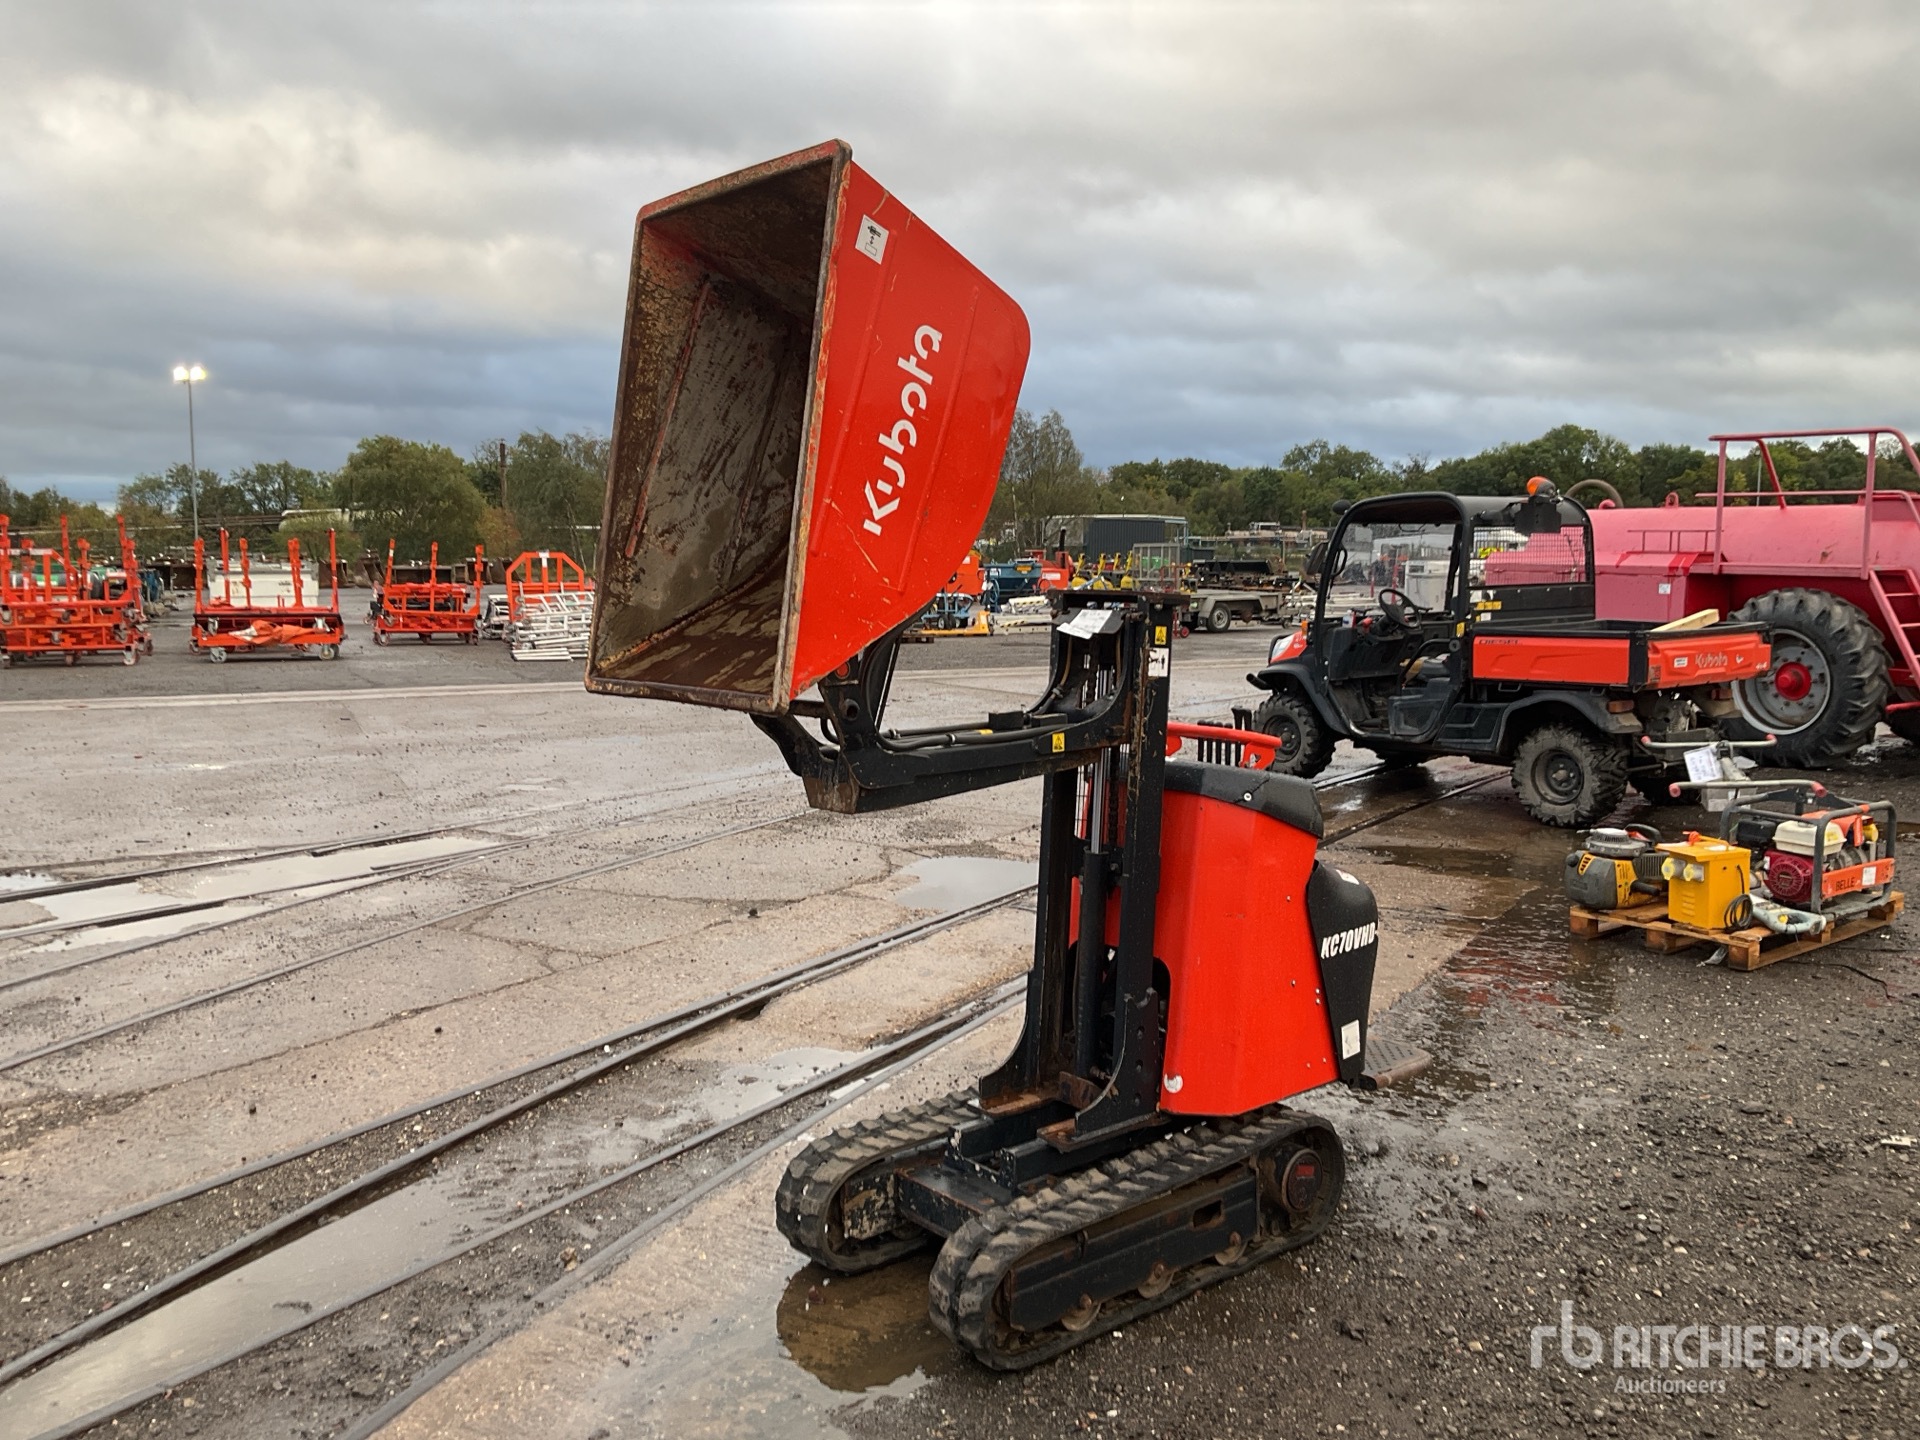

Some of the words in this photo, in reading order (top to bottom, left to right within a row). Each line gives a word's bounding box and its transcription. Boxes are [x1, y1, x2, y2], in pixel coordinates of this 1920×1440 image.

[863, 324, 943, 537] Kubota
[1695, 652, 1728, 668] Kubota
[1835, 876, 1856, 891] BELLE
